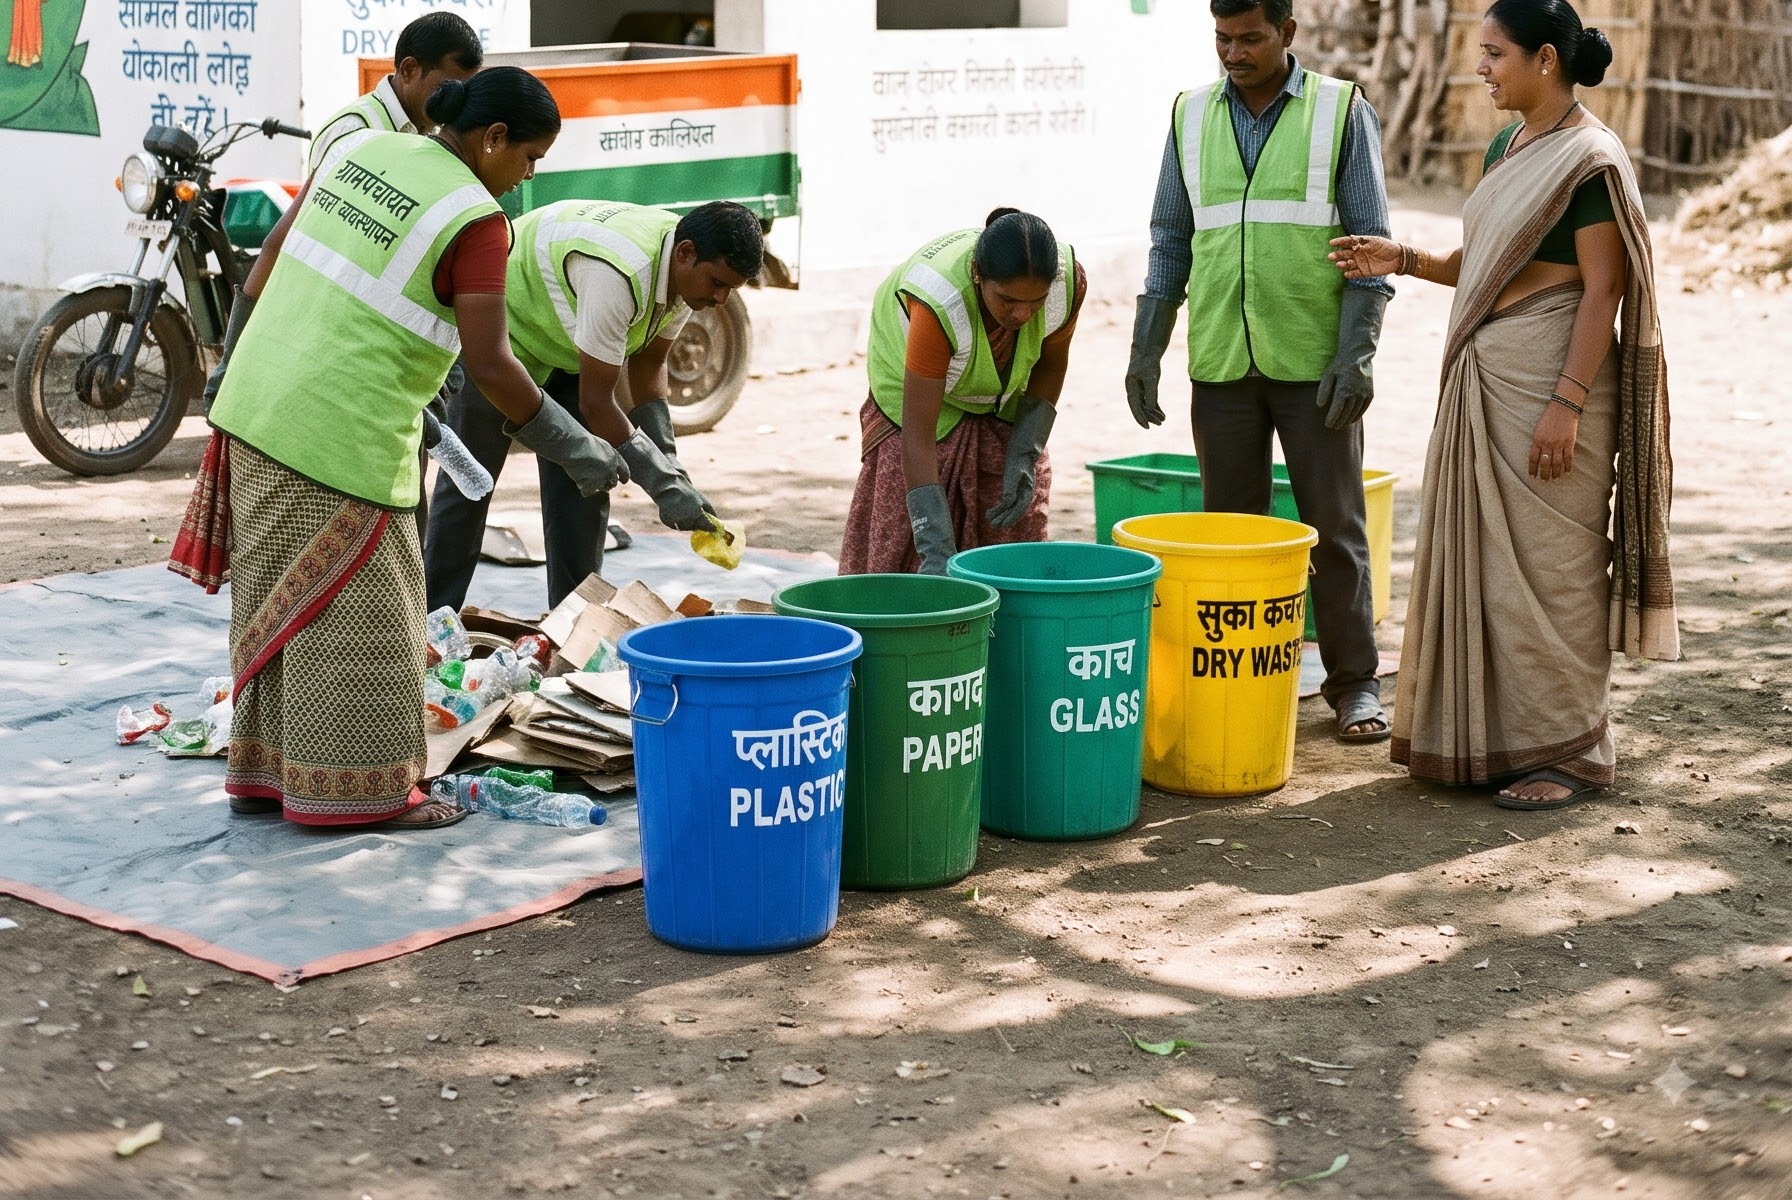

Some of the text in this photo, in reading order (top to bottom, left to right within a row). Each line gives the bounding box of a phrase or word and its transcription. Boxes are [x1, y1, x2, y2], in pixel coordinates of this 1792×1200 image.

[342, 29, 393, 55] DRY
[1197, 600, 1257, 643] सुका
[1066, 638, 1136, 680] काच
[1192, 646, 1245, 679] DRY
[907, 666, 986, 716] कागद
[1050, 689, 1140, 733] GLASS
[732, 710, 847, 770] प्लास्टिक
[903, 722, 983, 774] PAPER
[730, 769, 844, 827] PLASTIC
